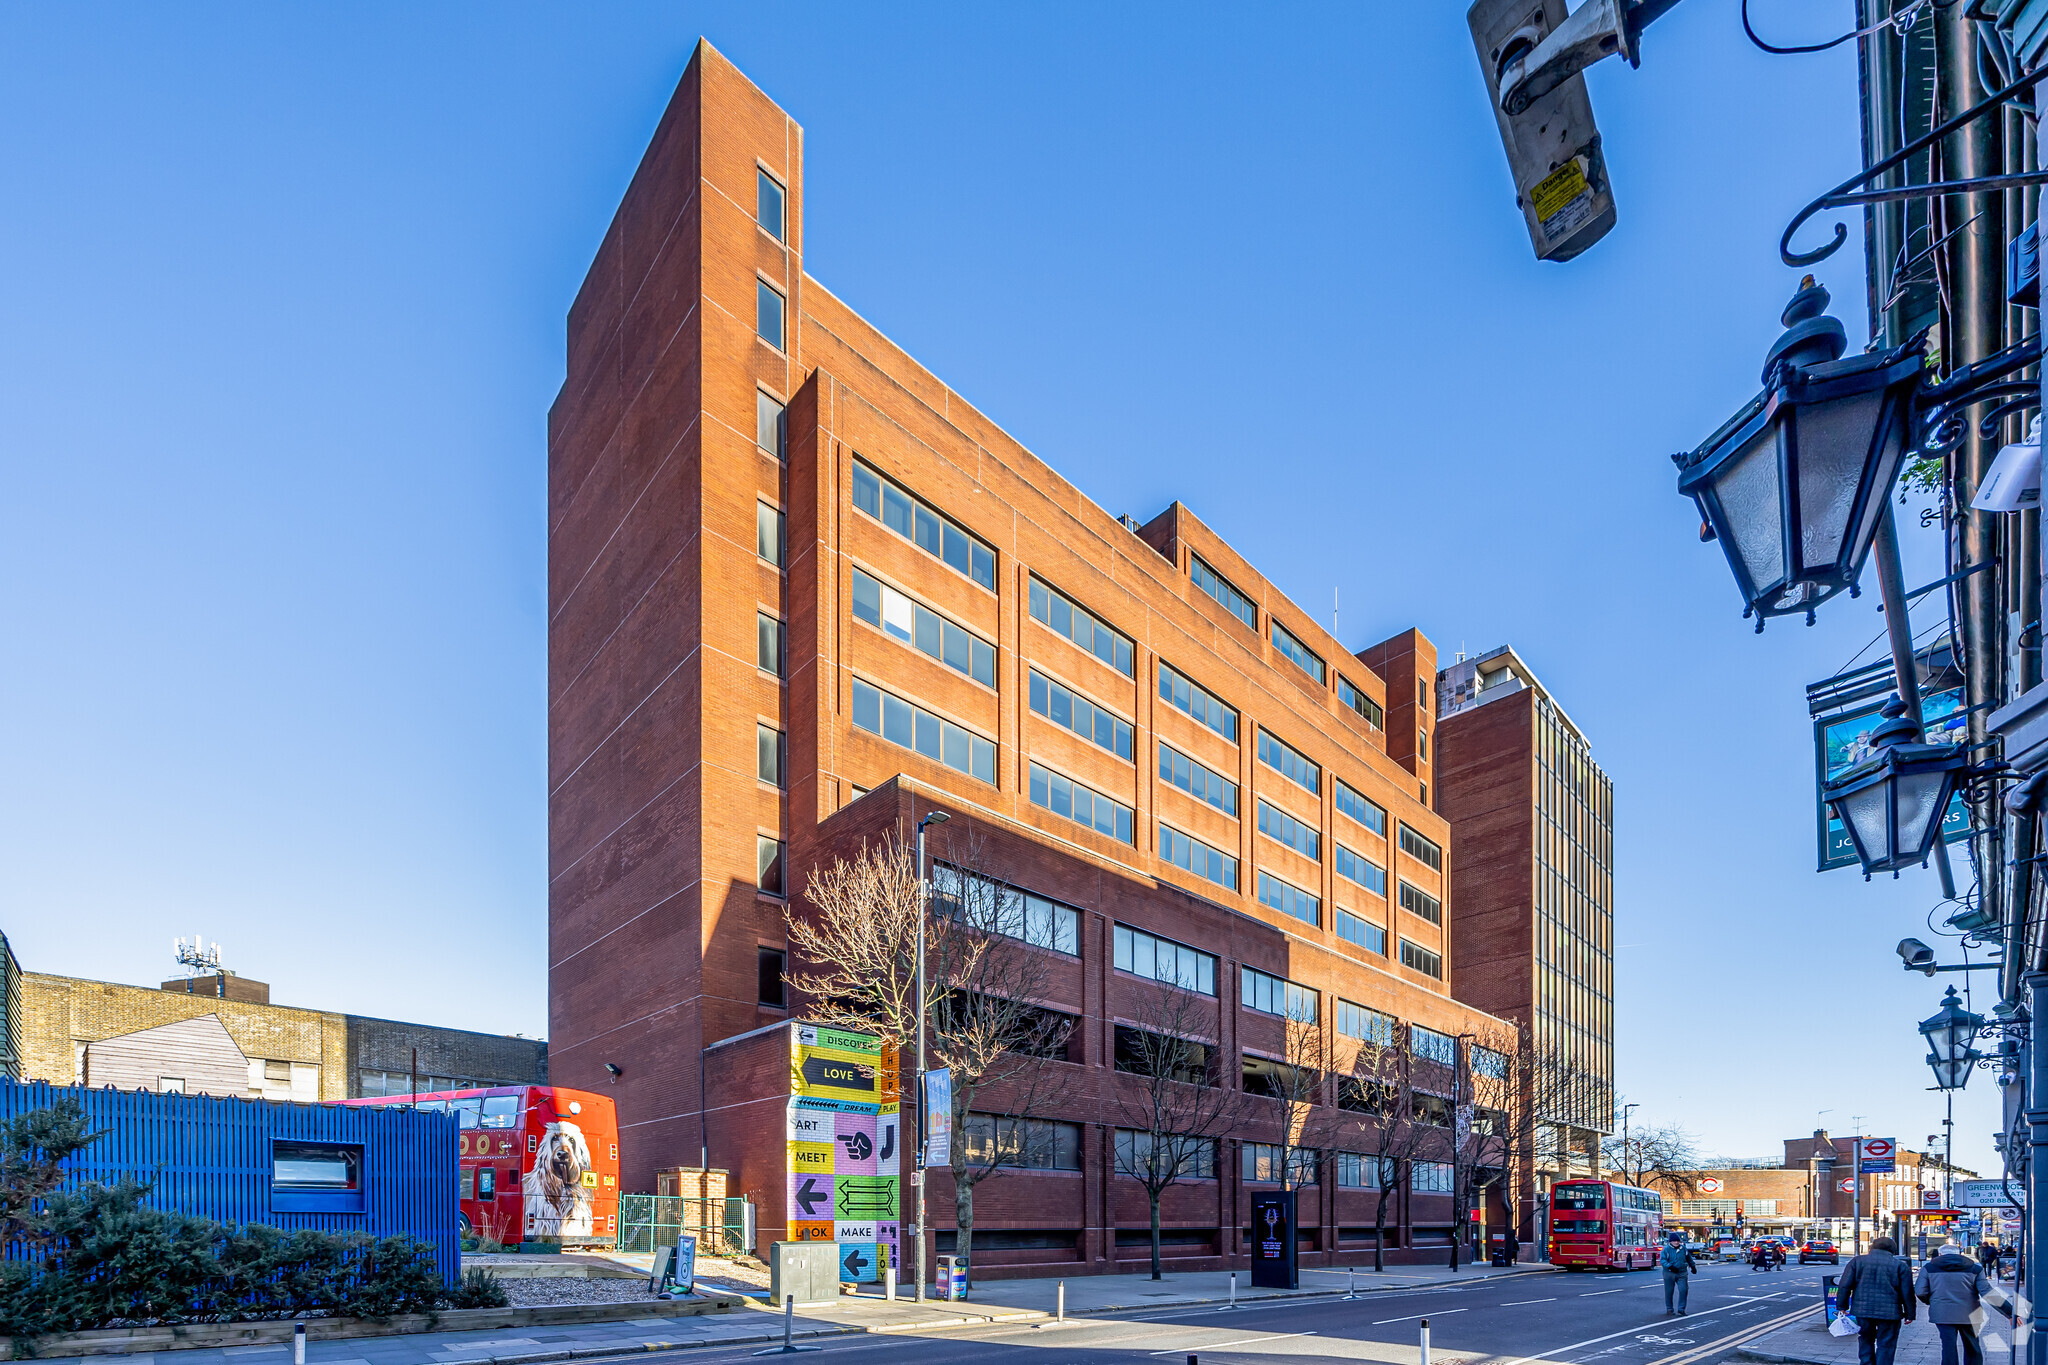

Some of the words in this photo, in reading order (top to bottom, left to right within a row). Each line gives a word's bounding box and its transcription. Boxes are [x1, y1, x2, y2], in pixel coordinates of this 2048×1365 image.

[1541, 167, 1570, 191] Danger
[824, 1067, 854, 1081] LOVE
[844, 1104, 872, 1113] DREAM
[882, 1104, 897, 1112] PLAY
[796, 1120, 818, 1130] ART
[796, 1152, 827, 1163] MEET
[1574, 1201, 1585, 1209] W3
[796, 1227, 828, 1238] LOK
[841, 1227, 872, 1237] MAKE
